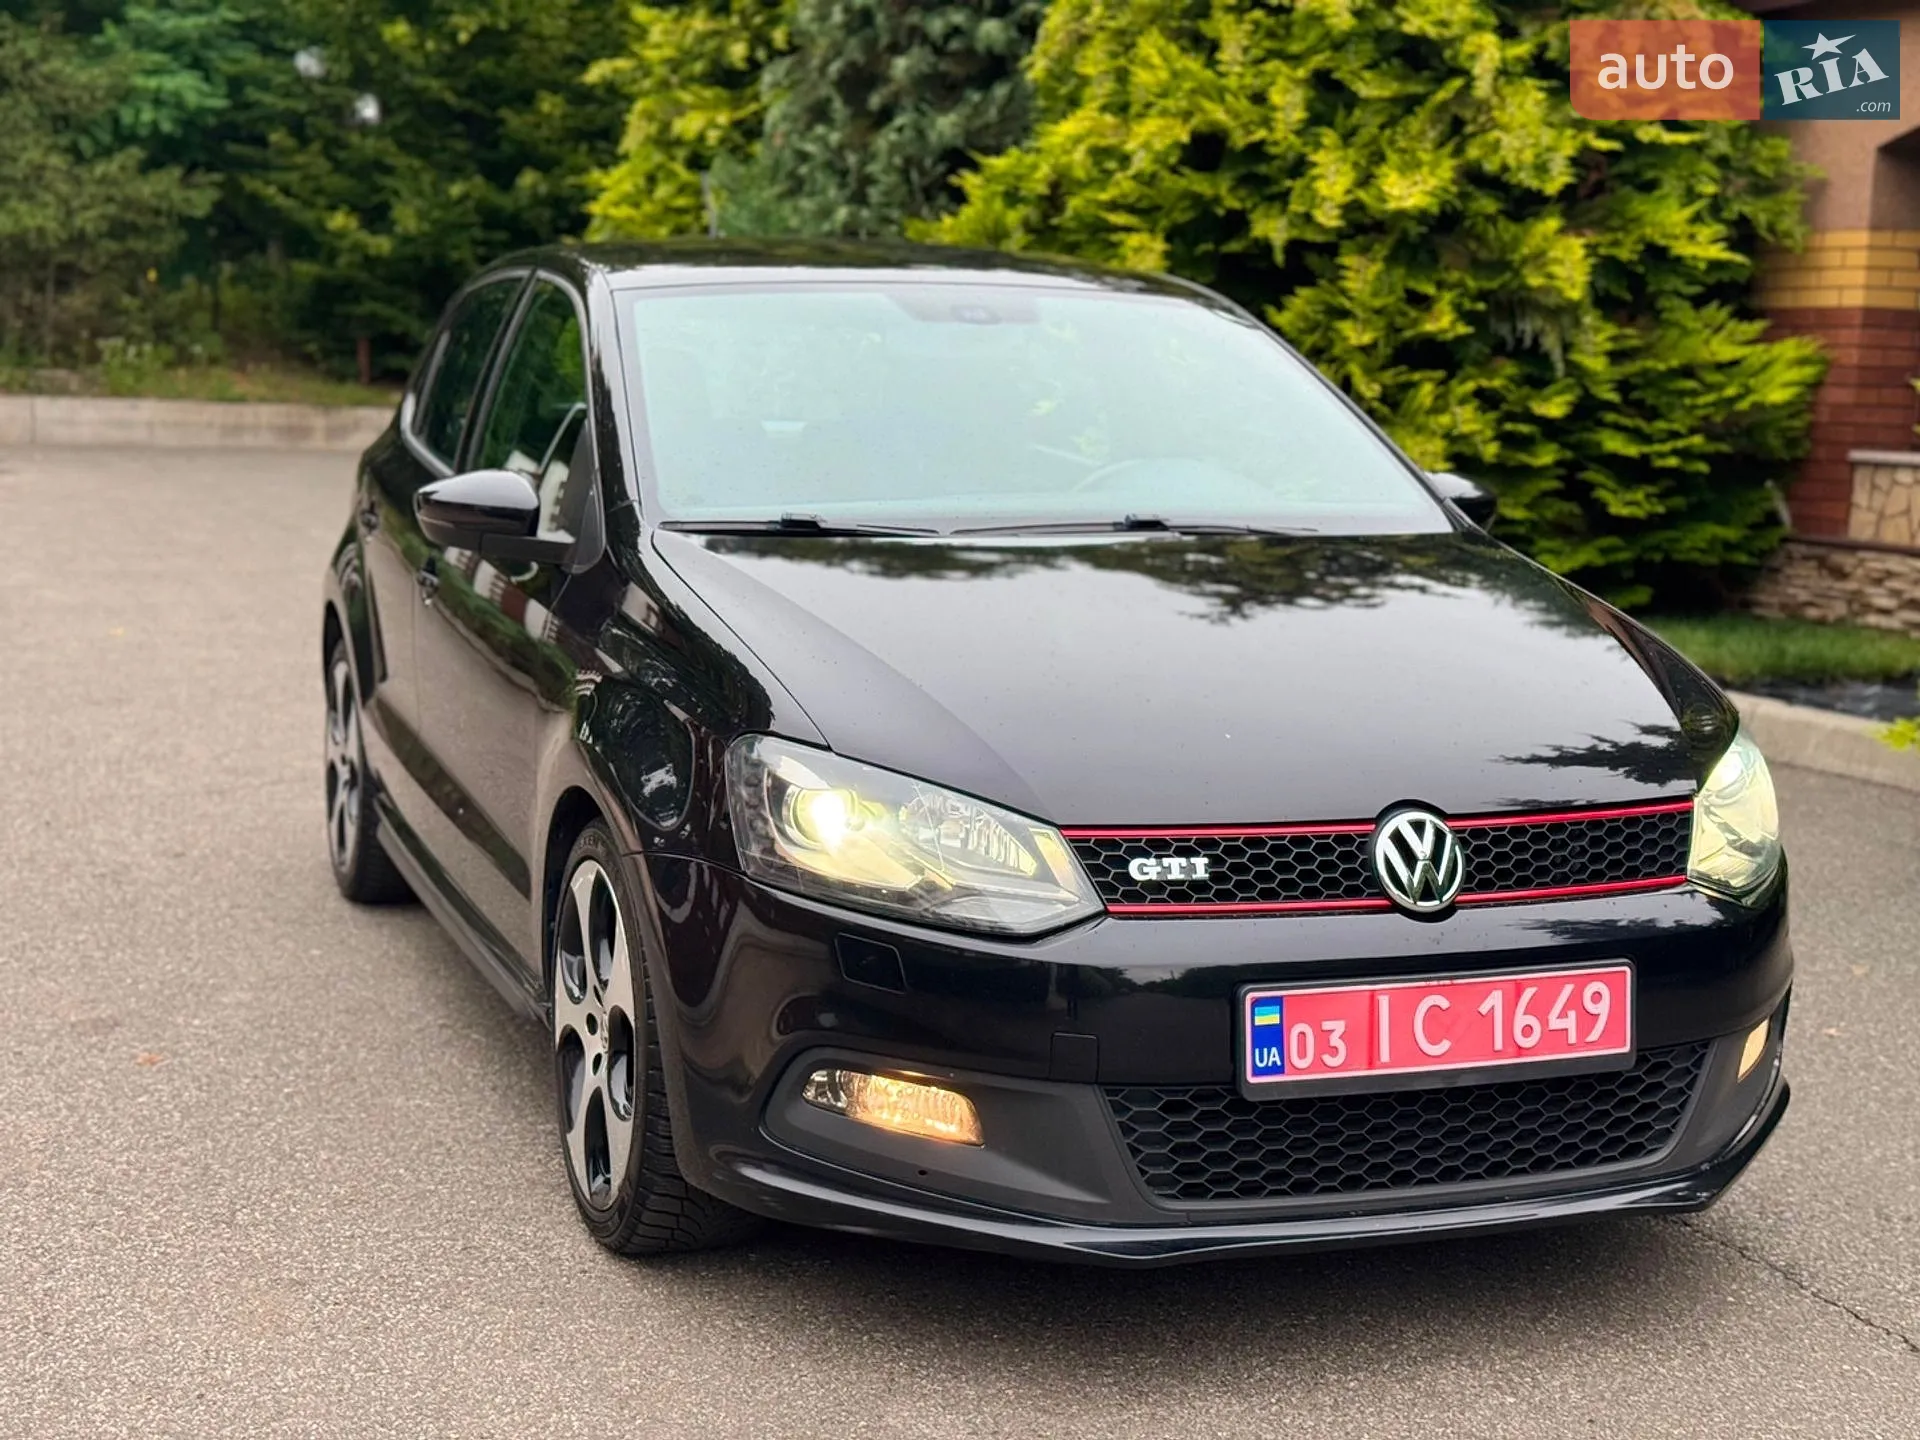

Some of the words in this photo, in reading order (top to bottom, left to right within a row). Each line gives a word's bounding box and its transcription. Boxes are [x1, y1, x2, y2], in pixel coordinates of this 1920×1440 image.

[1128, 857, 1209, 881] GTI
[1380, 813, 1457, 907] VW
[1289, 1019, 1347, 1070] 03
[1477, 981, 1611, 1052] 1649
[1255, 1046, 1282, 1067] UA
